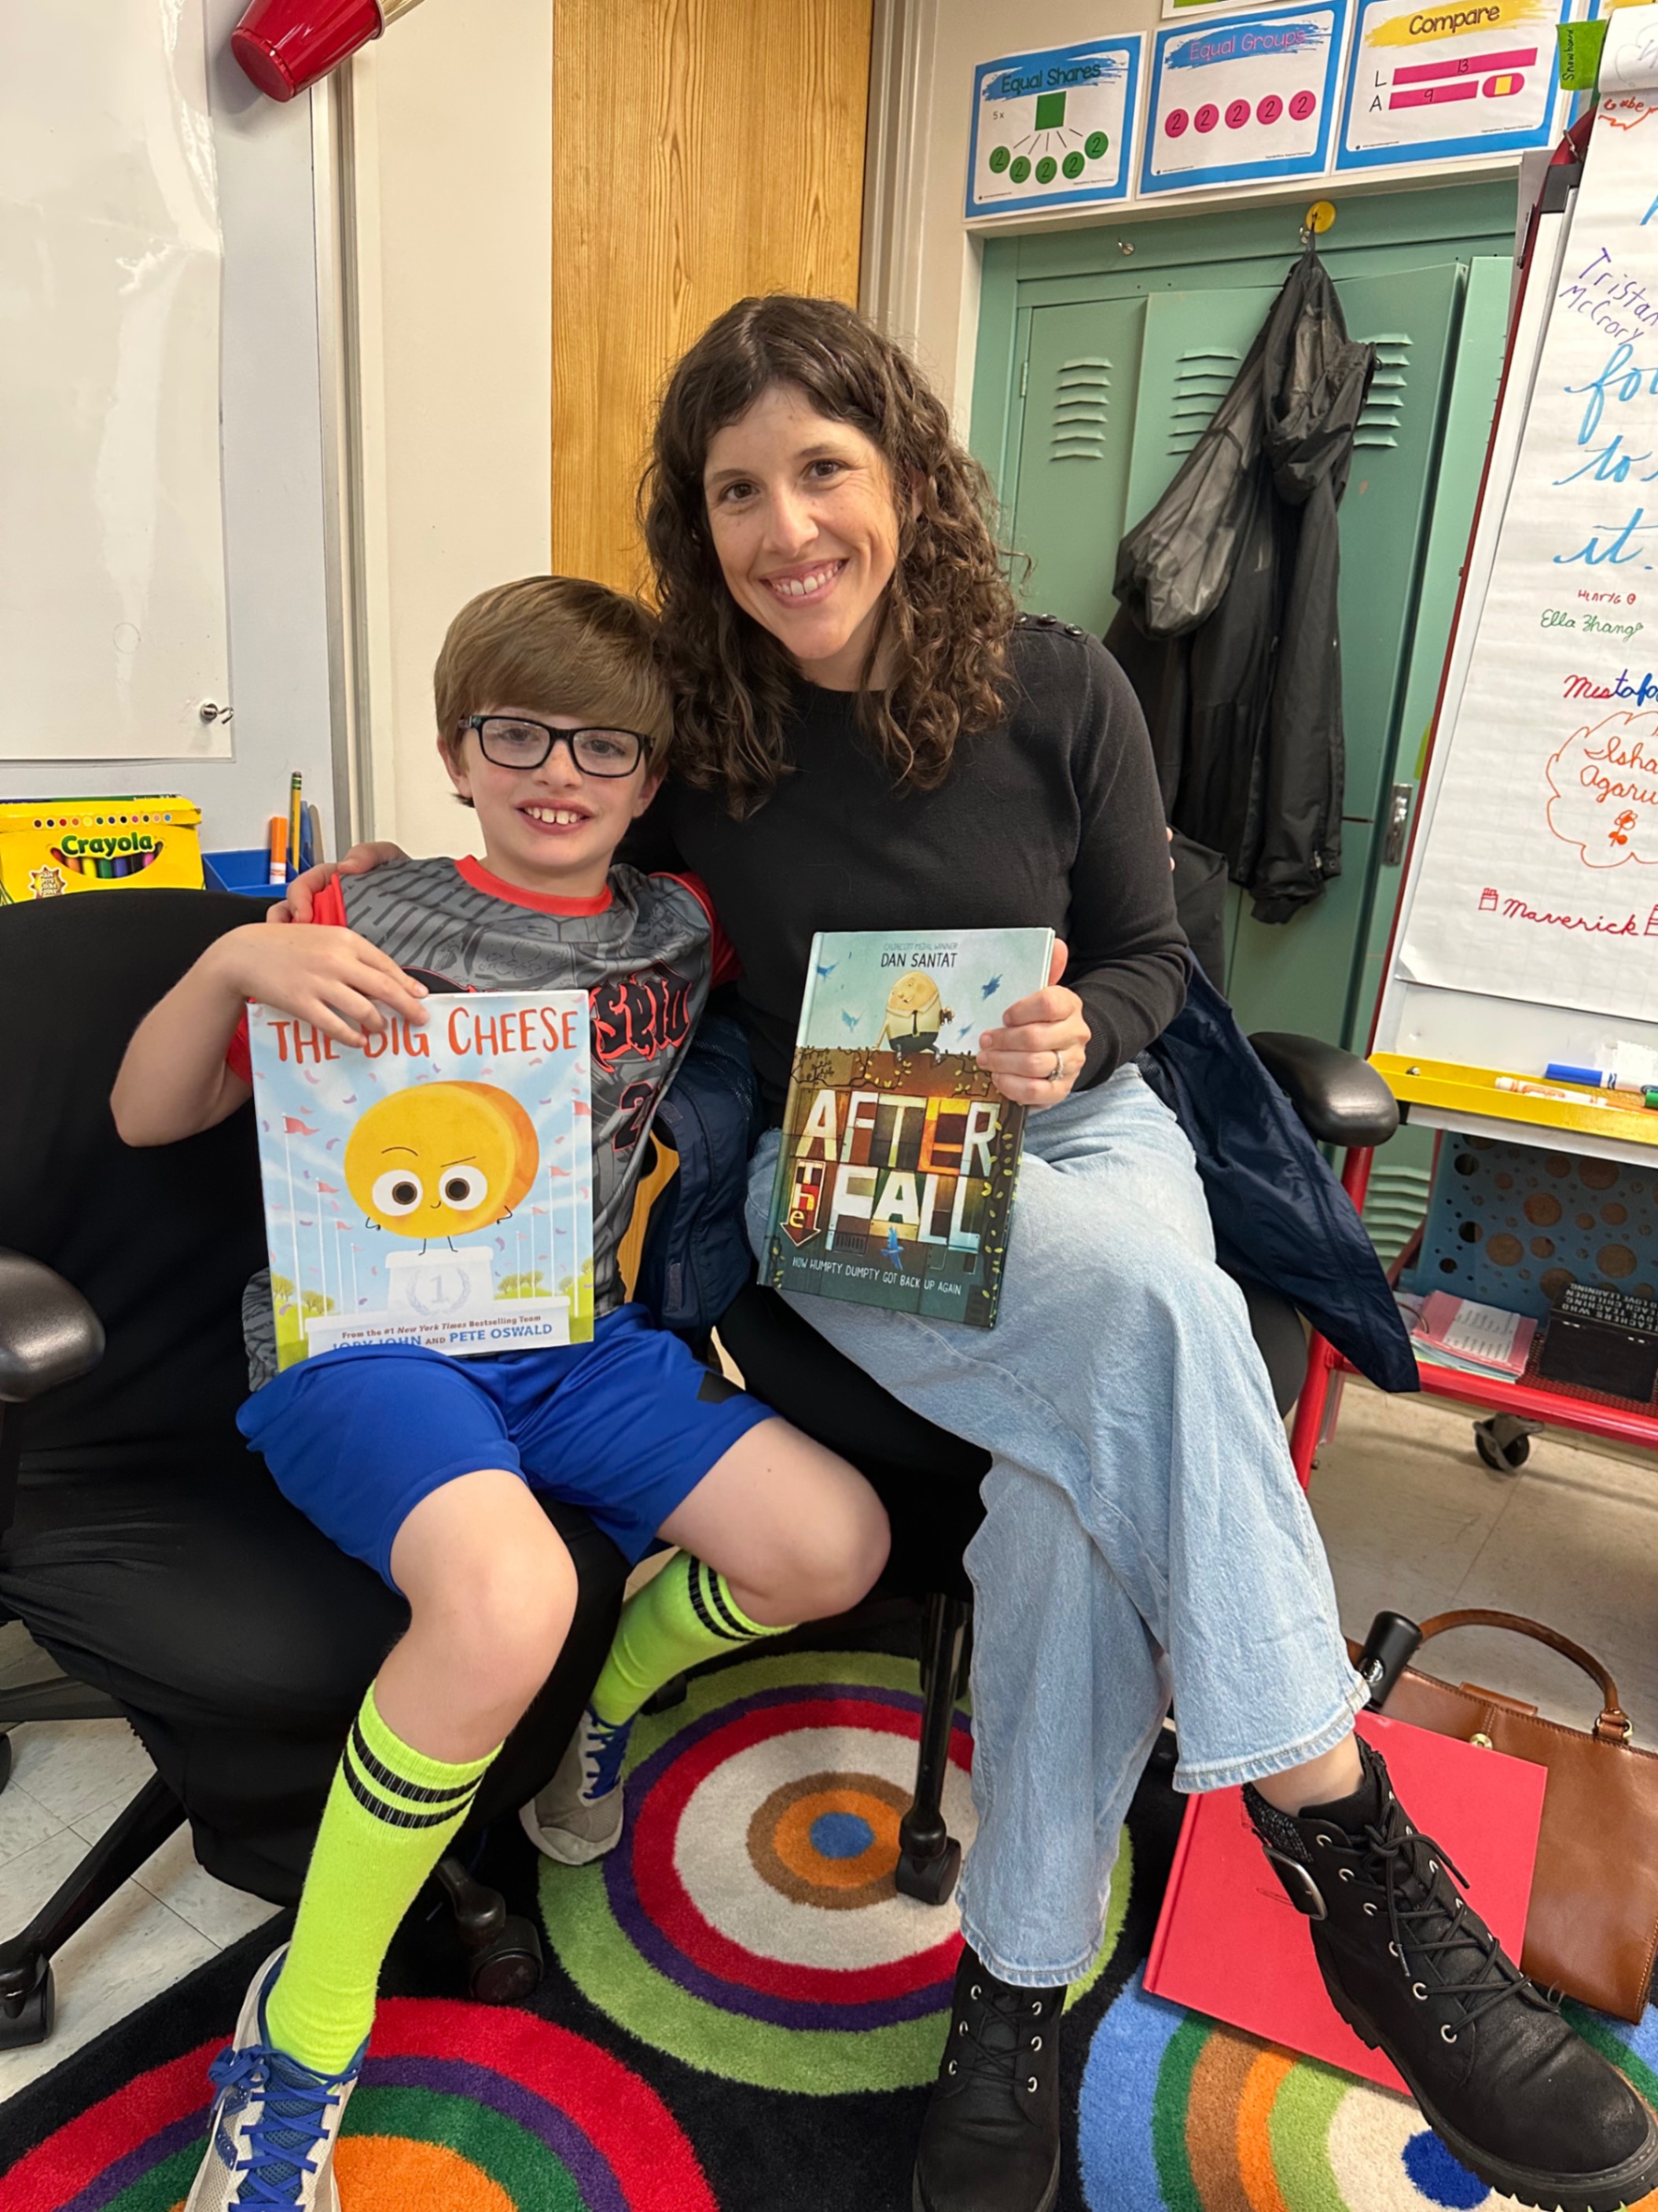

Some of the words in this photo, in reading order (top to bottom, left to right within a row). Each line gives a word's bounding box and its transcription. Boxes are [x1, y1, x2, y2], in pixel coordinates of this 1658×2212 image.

[1409, 6, 1501, 35] Compare
[1189, 36, 1236, 61] Equal
[1241, 30, 1307, 51] Groups
[1562, 29, 1575, 81] Snowboard
[1001, 71, 1042, 95] Equal
[1047, 64, 1101, 86] Shares
[1374, 70, 1387, 87] L
[1457, 59, 1469, 73] 13
[1171, 113, 1182, 131] 2
[1200, 109, 1211, 127] 2
[1233, 105, 1243, 122] 2
[1265, 101, 1275, 118] 2
[1297, 96, 1307, 113] 2
[1369, 95, 1383, 112] A
[1424, 89, 1434, 103] 9
[1092, 137, 1101, 153] 2
[995, 150, 1005, 166] 2
[1015, 161, 1024, 177] 2
[1042, 162, 1050, 178] 2
[1069, 156, 1078, 173] 2
[1552, 435, 1652, 485] to
[1540, 609, 1575, 628] Ella
[1583, 614, 1638, 642] Zhang
[61, 832, 153, 859] Crayola
[1502, 898, 1639, 936] Maverick
[881, 953, 906, 967] DAN
[910, 952, 958, 968] SANTAT
[448, 1007, 579, 1055] CHEESE
[796, 1089, 1001, 1177] AFTER
[825, 1165, 980, 1253] FALL
[429, 1274, 450, 1304] 1
[792, 1257, 807, 1268] HOW
[810, 1259, 844, 1274] HUMPTY
[845, 1265, 880, 1281] DUMPTY
[882, 1272, 897, 1283] GOT
[899, 1275, 921, 1288] BACK
[924, 1280, 936, 1290] UP
[937, 1283, 961, 1295] AGAIN
[419, 1323, 439, 1332] York
[469, 1317, 517, 1327] Bestselling
[1626, 1303, 1658, 1316] EACH
[1633, 1312, 1658, 1323] OVE
[425, 1337, 446, 1345] AND
[450, 1330, 486, 1343] PETE
[491, 1323, 553, 1339] OSWALD
